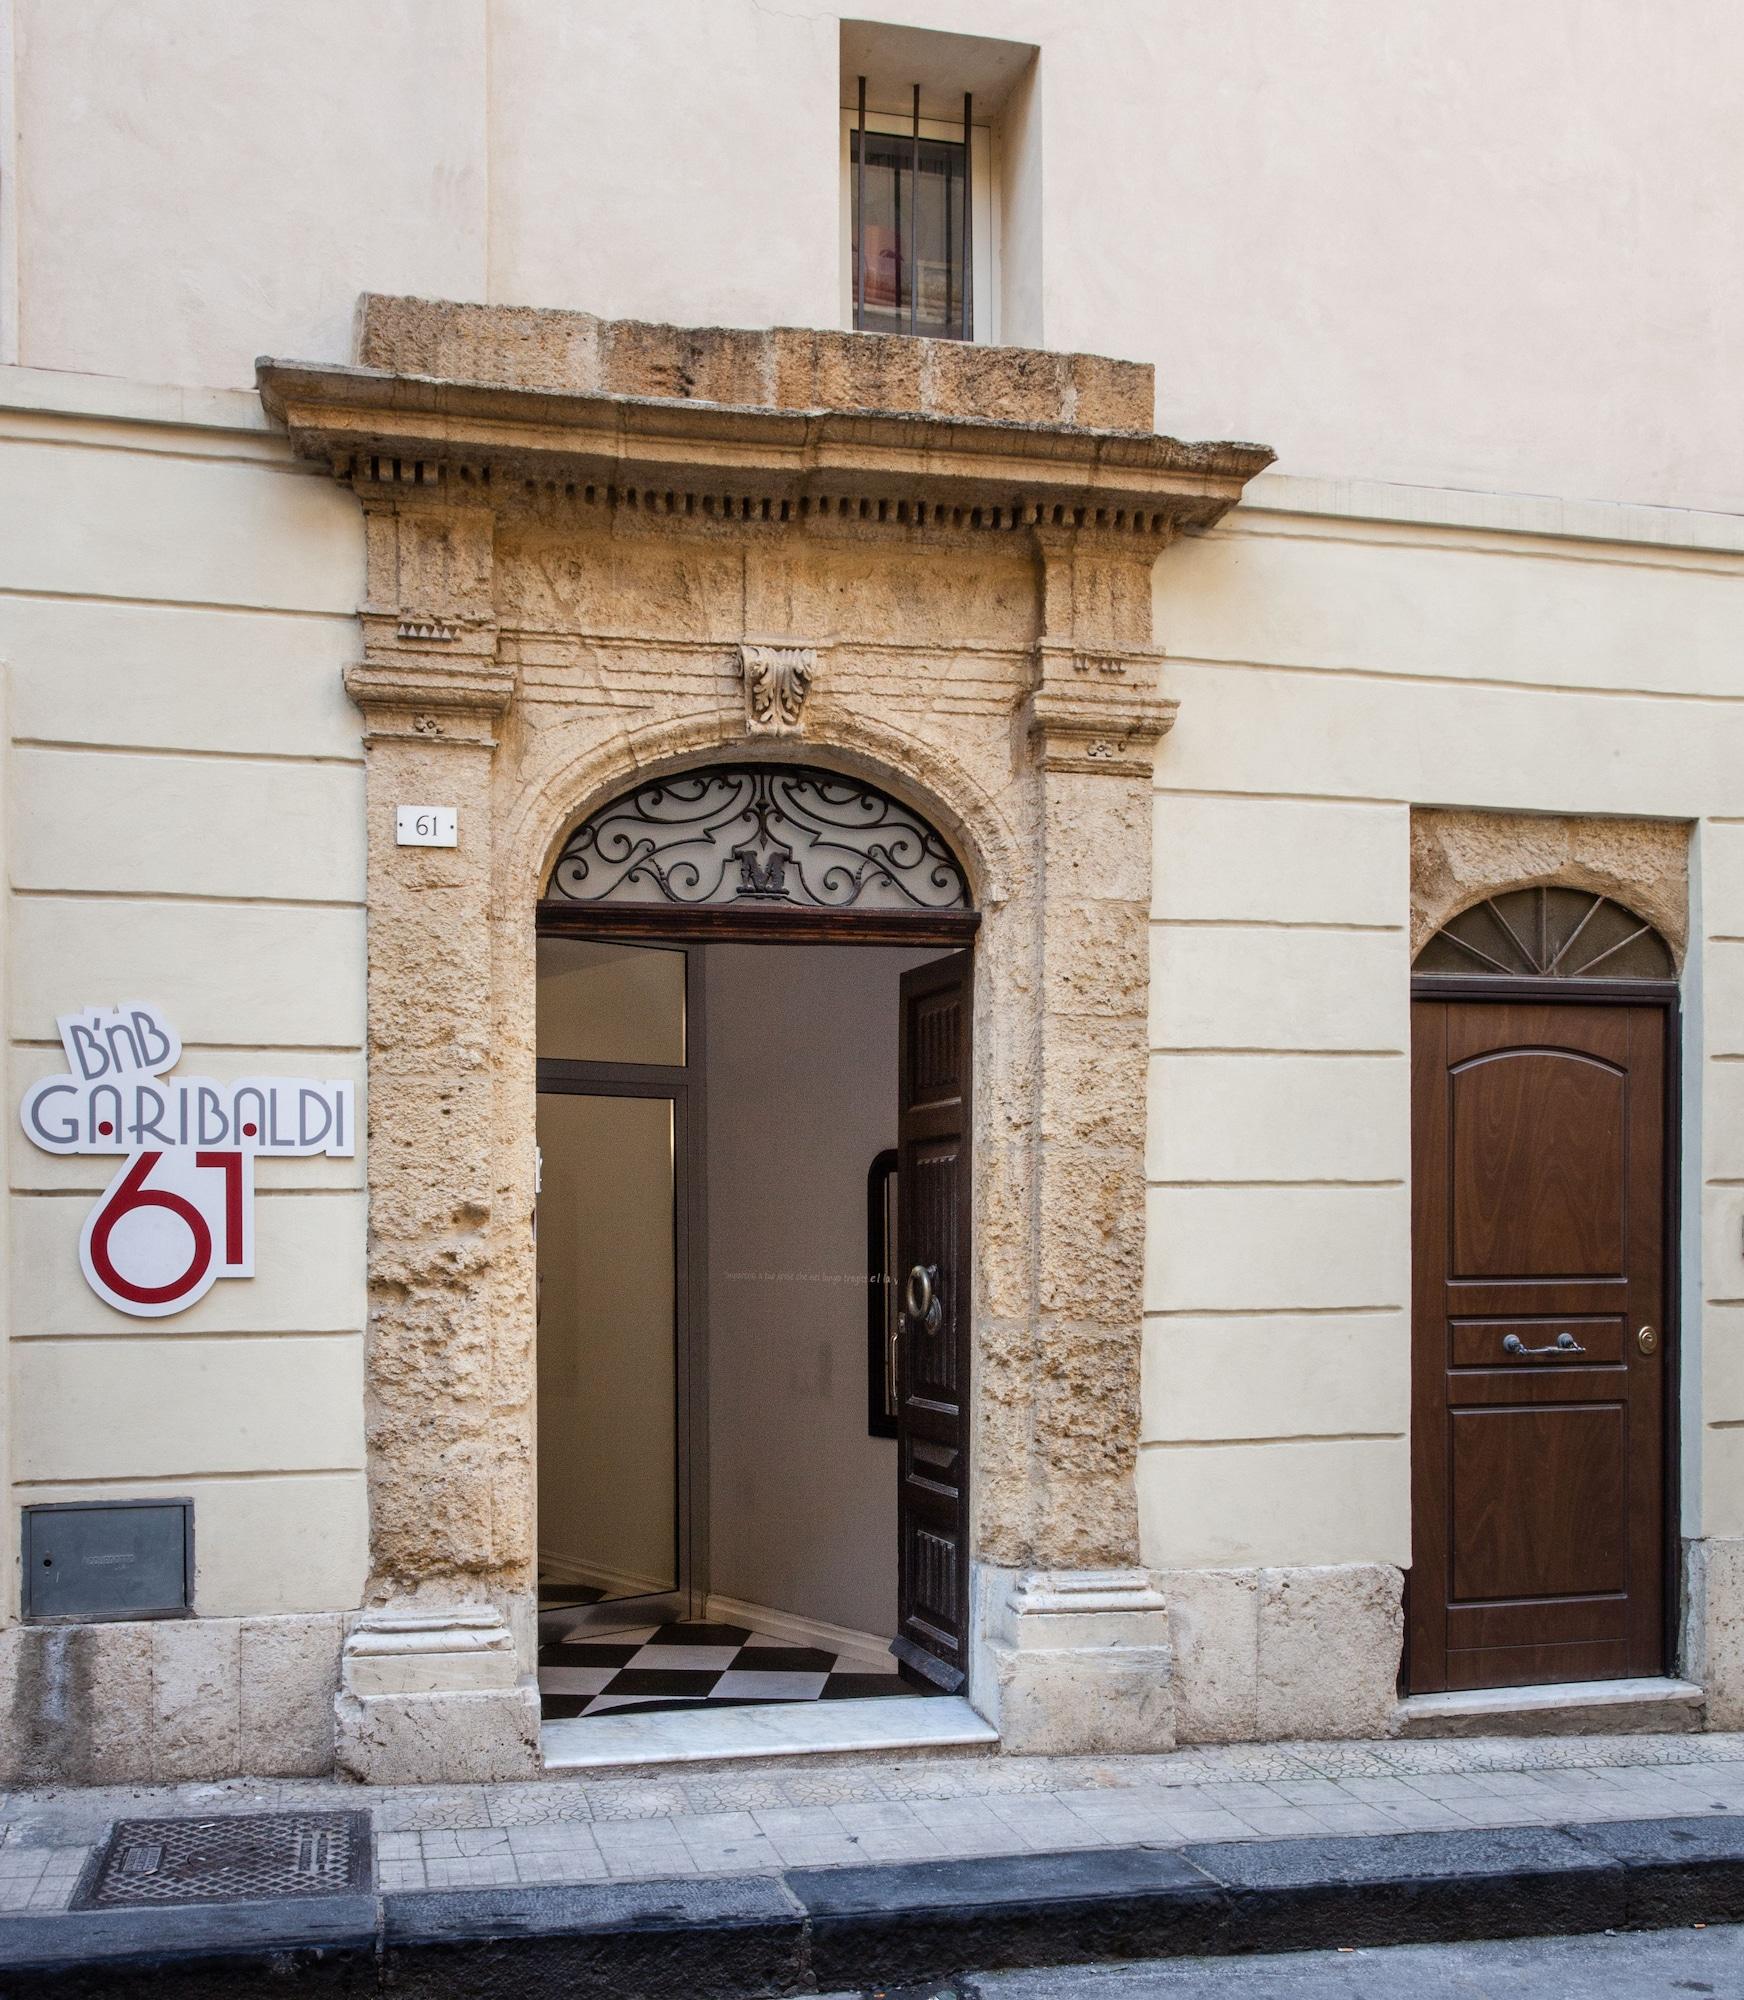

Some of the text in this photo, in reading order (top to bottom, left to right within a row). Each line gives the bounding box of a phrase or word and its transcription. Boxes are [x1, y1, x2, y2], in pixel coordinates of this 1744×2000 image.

[416, 815, 437, 836] 61
[31, 1084, 344, 1148] GARIBALDI
[90, 1151, 243, 1304] 61
